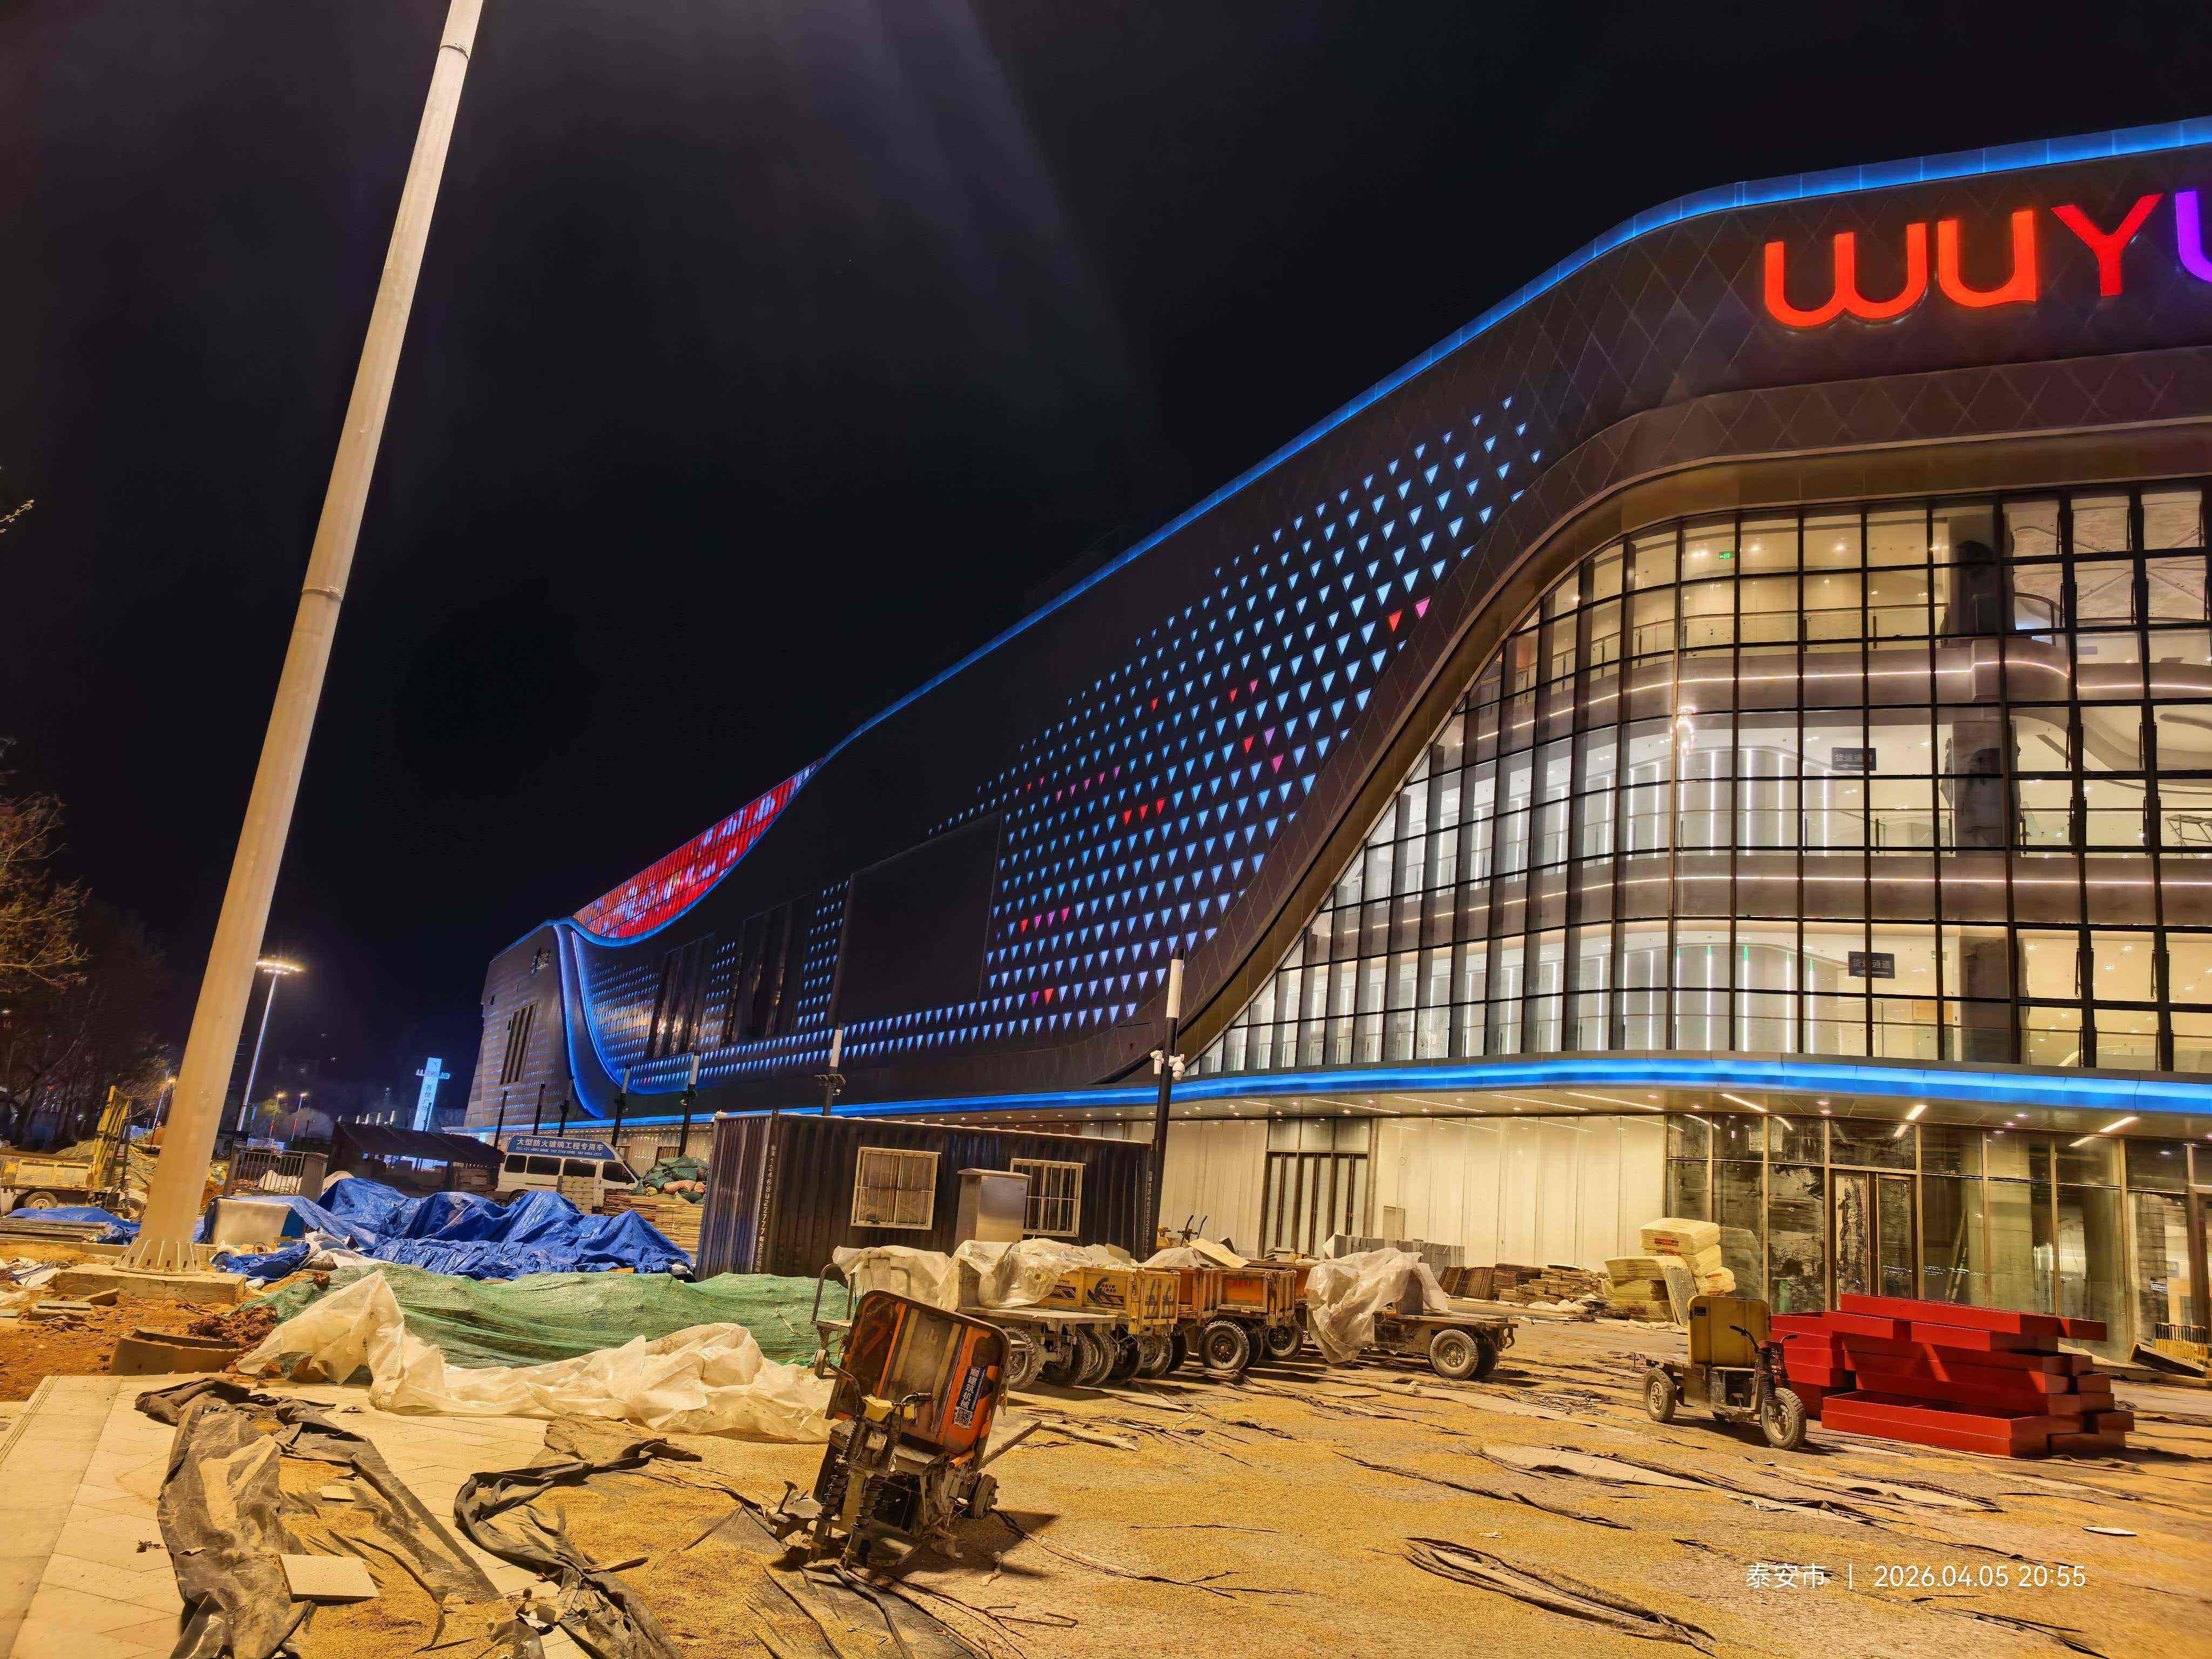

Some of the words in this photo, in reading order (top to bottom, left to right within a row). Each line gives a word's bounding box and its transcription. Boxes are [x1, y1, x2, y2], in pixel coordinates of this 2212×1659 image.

[516, 1138, 604, 1151] 大型防火玻璃工程专用车
